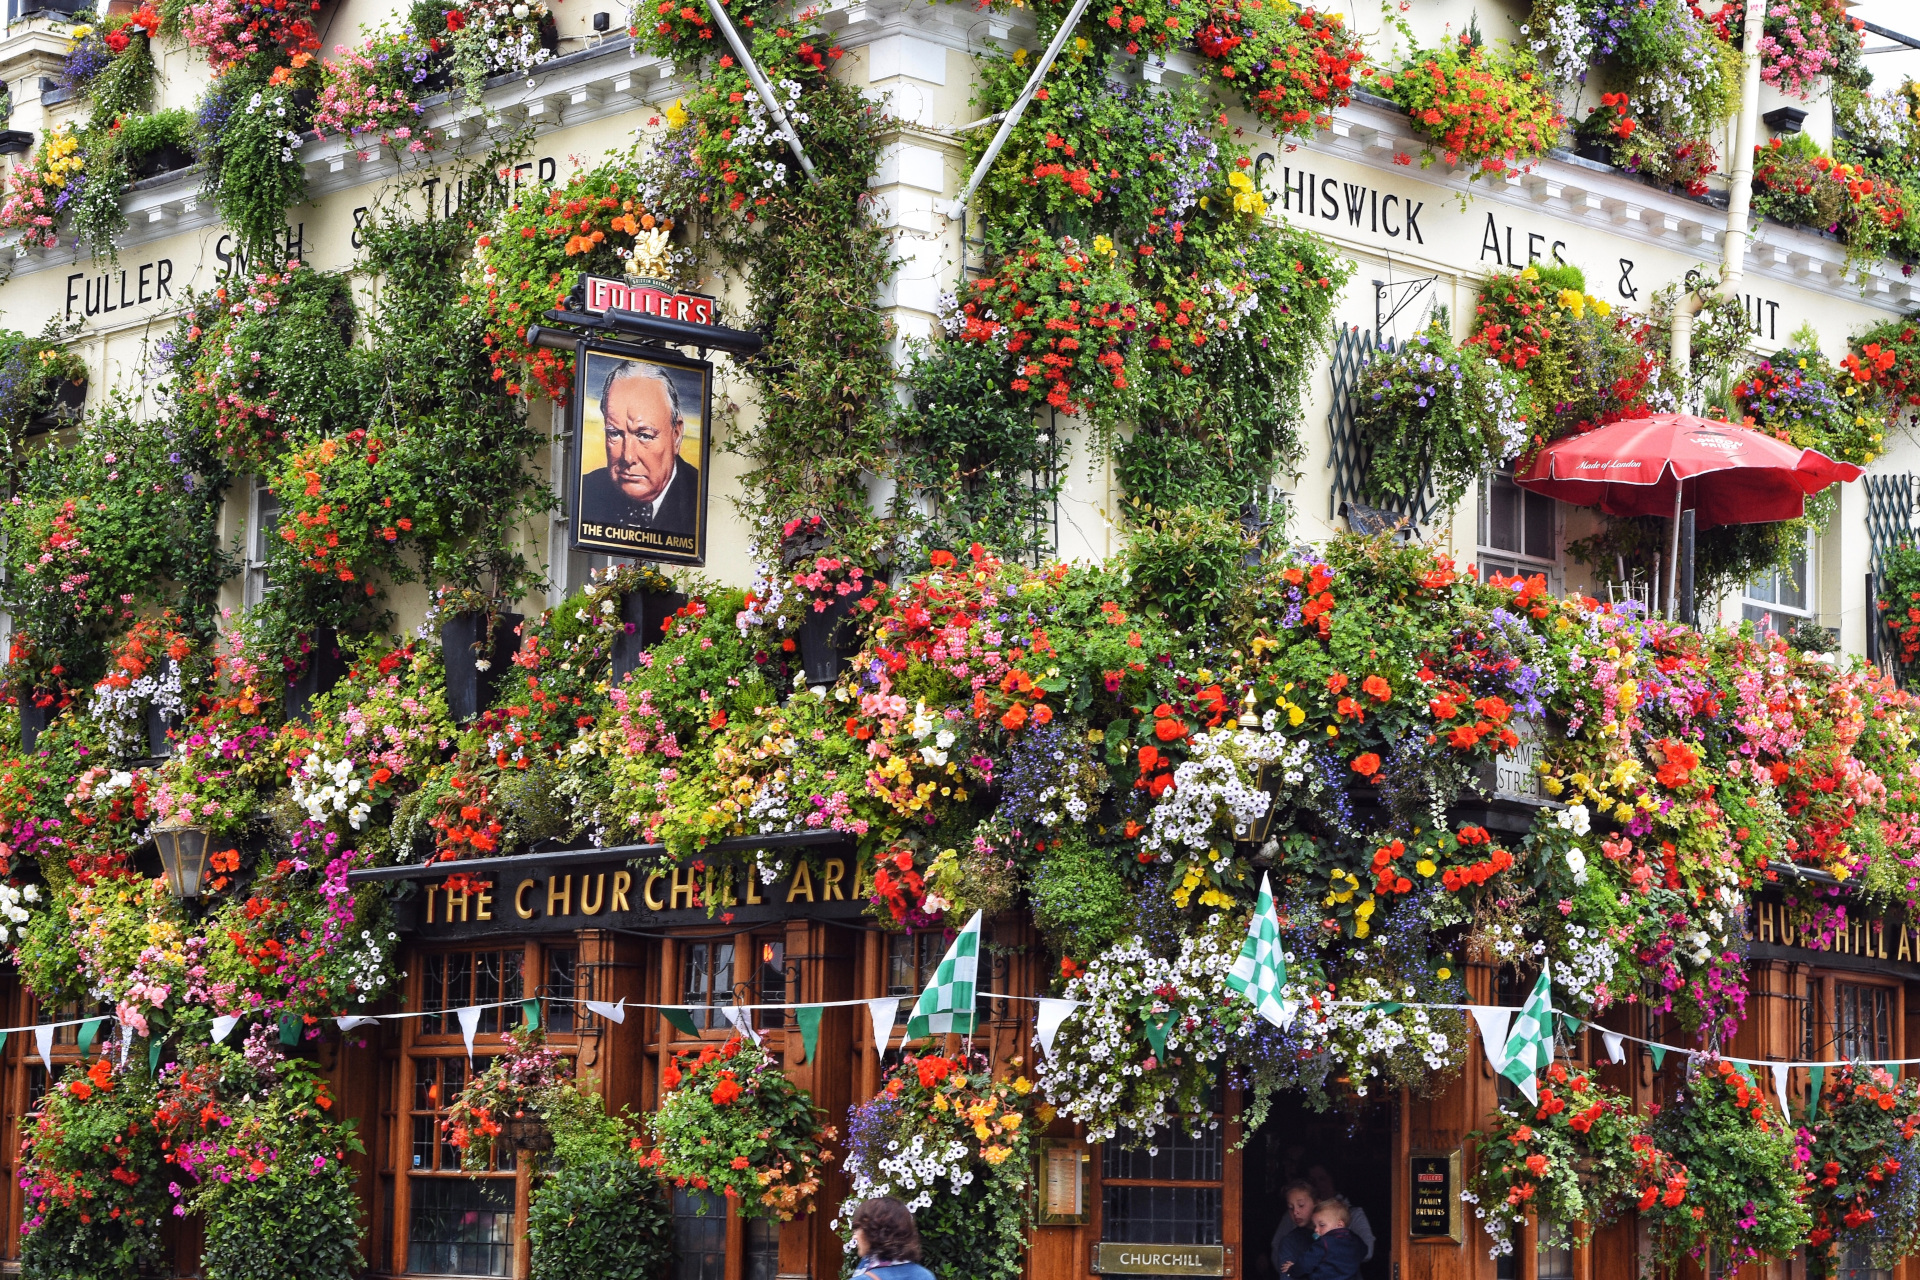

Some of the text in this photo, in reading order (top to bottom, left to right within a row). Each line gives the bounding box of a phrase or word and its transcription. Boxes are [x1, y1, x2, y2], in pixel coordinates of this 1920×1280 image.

[1254, 152, 1424, 244] CHISWICK
[1480, 212, 1567, 271] ALES
[1618, 258, 1638, 301] &
[65, 258, 173, 322] FULLER
[215, 222, 304, 284] SMTH
[351, 206, 368, 249] &
[594, 281, 708, 325] FULLER'S
[1576, 459, 1642, 471] Made of London
[582, 523, 694, 550] THE CHURCHILL ARMS
[424, 881, 493, 924] THE
[514, 861, 762, 920] CHURCHILL
[1415, 1208, 1446, 1216] BREWERS
[1120, 1252, 1202, 1267] CHURCHILL
